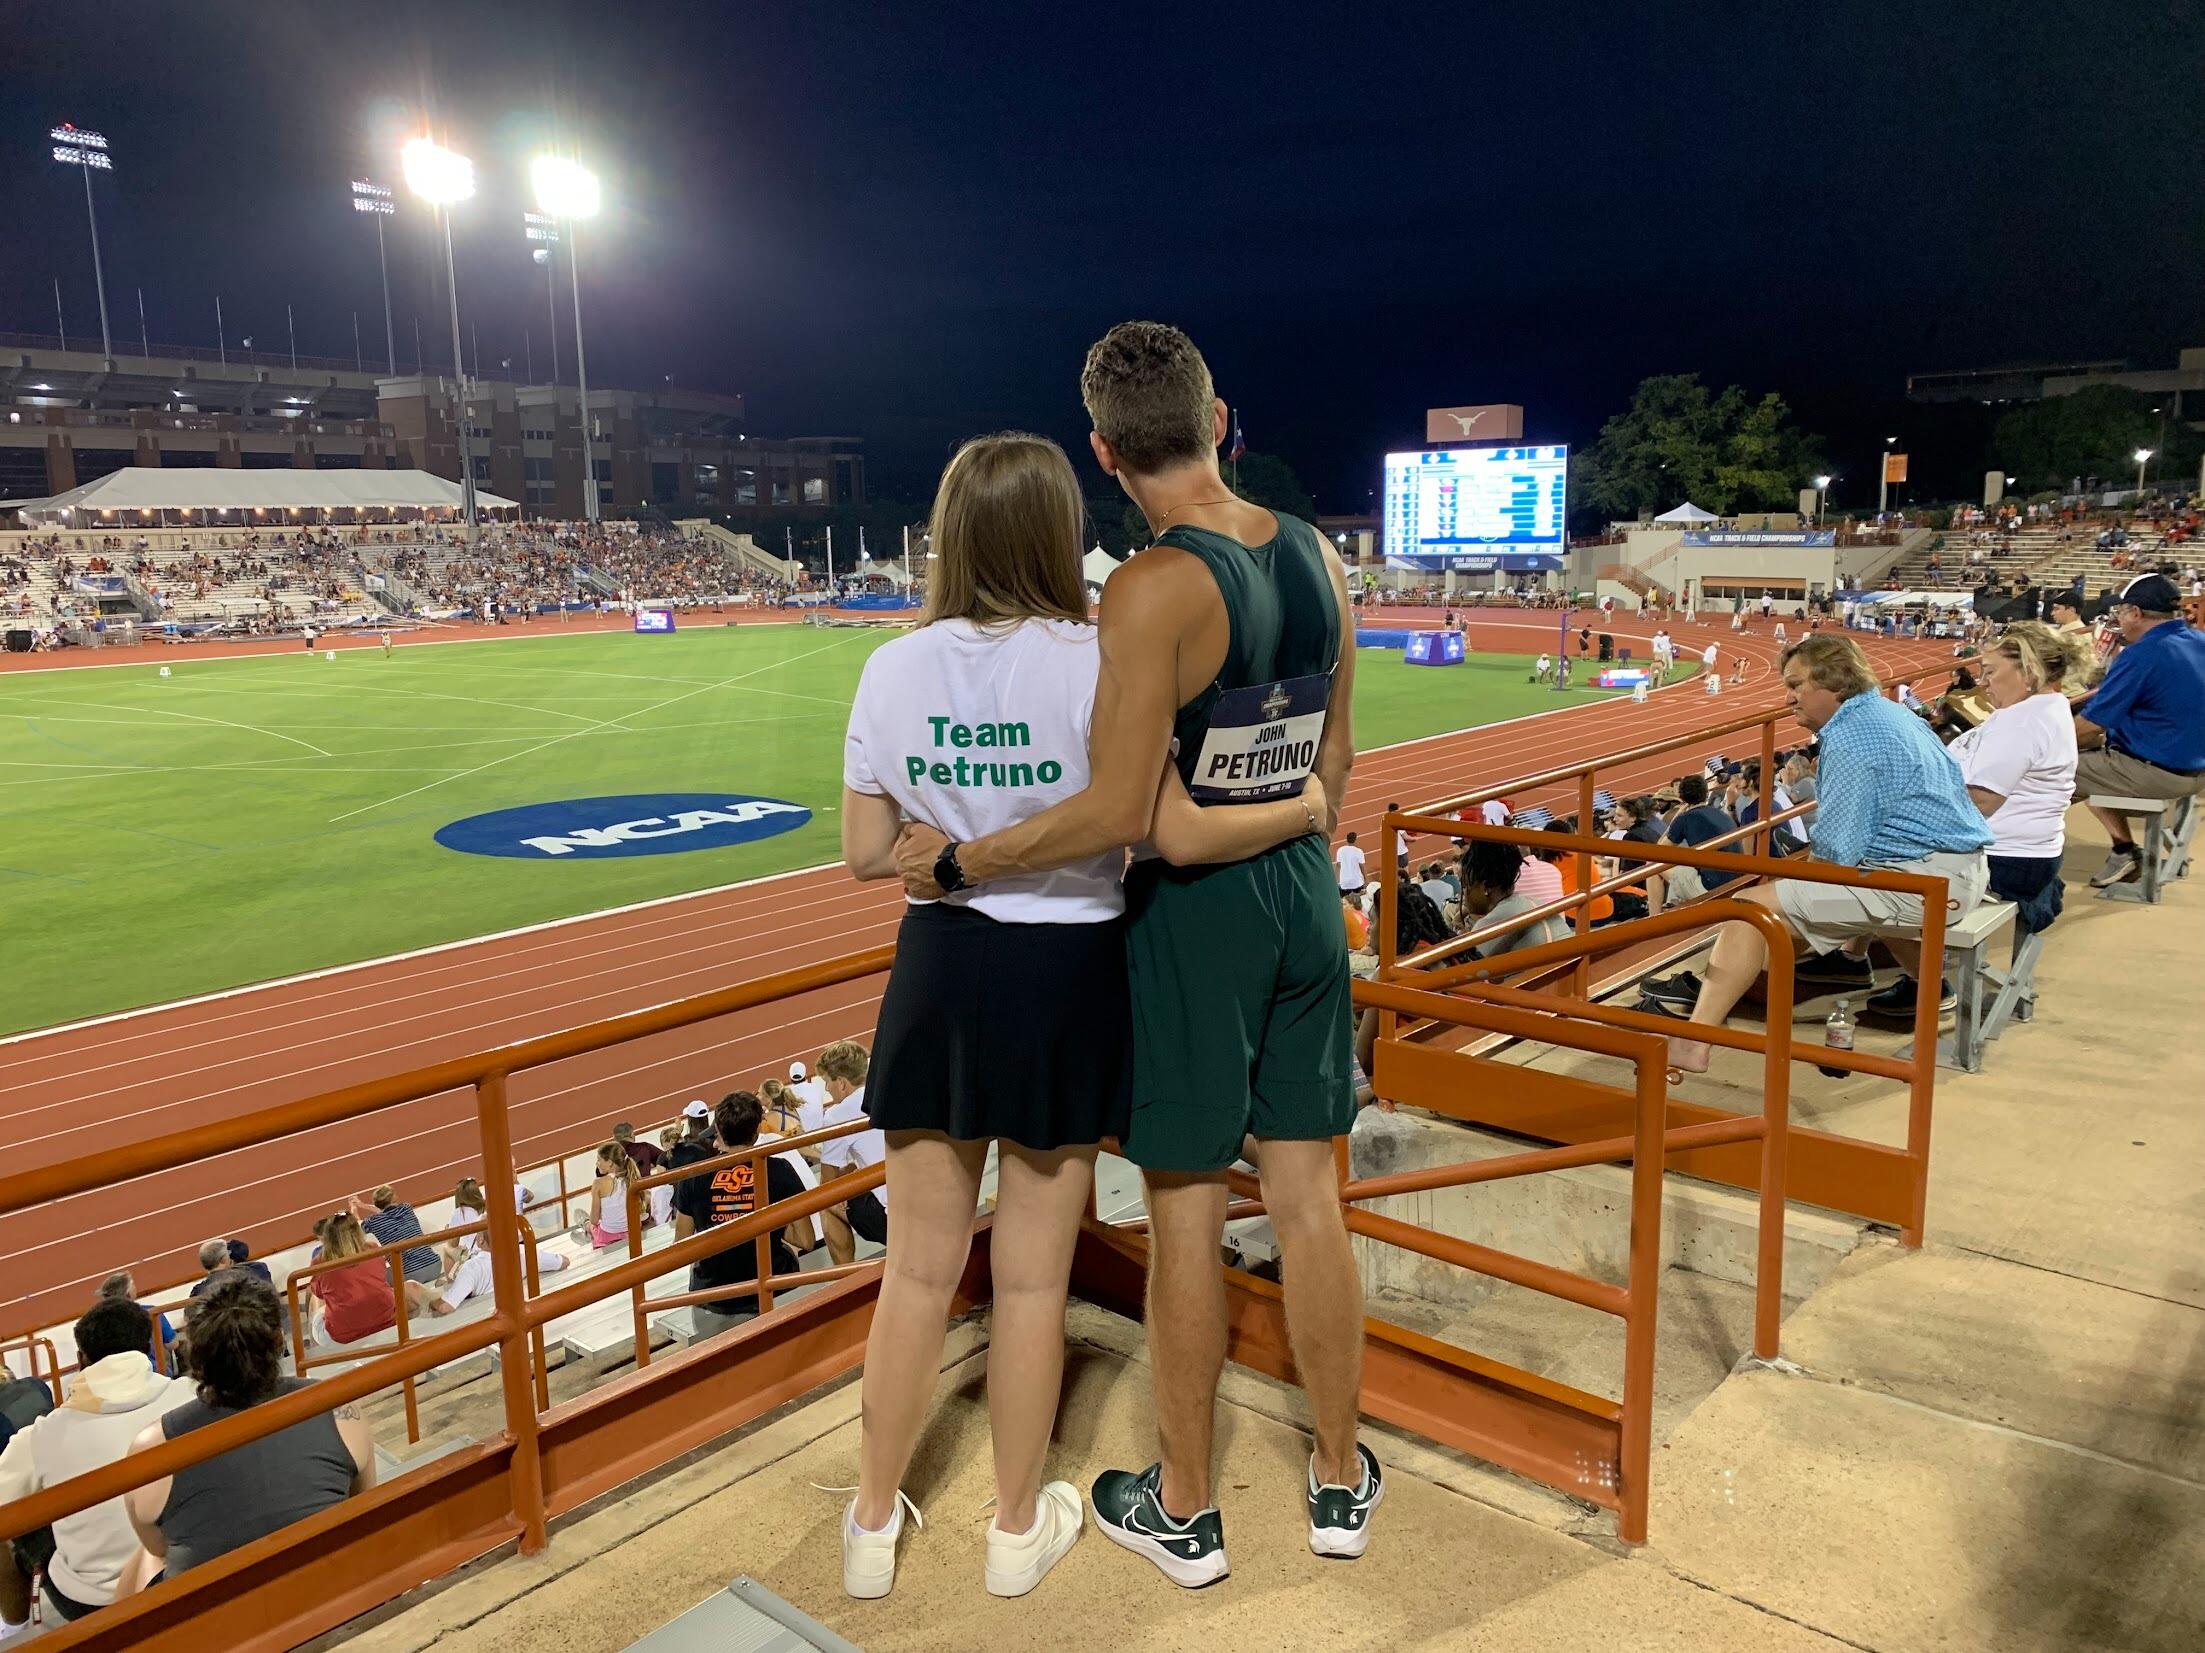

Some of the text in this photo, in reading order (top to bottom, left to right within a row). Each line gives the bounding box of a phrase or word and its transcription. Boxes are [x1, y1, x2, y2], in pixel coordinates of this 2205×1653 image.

[928, 716, 1031, 748] Team
[1255, 723, 1287, 745] JOHN
[906, 756, 1062, 787] Petruno
[1207, 740, 1314, 780] PETRUNO
[1267, 784, 1281, 793] JUNE
[519, 801, 811, 855] NCAA
[712, 1193, 754, 1202] OKLAHOMA STAT
[1229, 1235, 1240, 1247] 16
